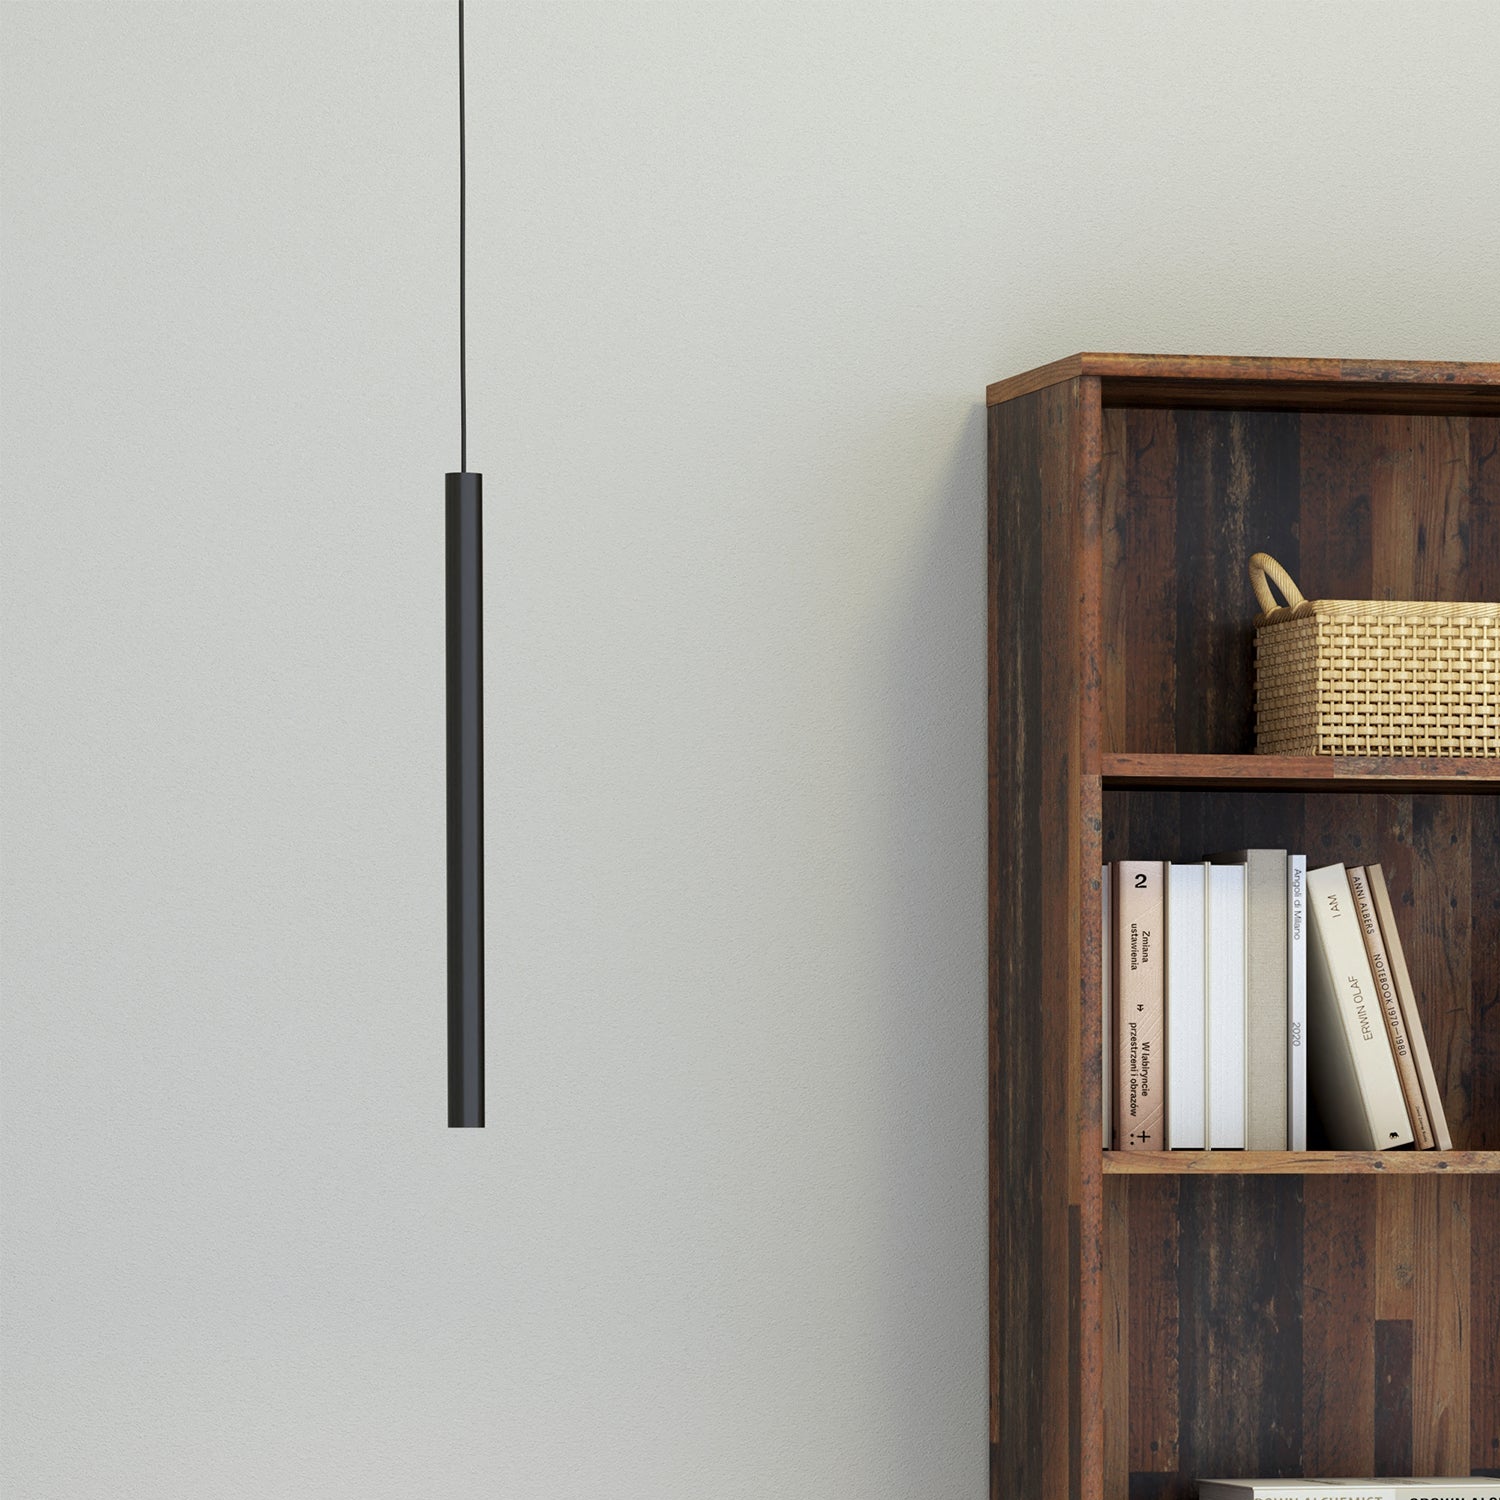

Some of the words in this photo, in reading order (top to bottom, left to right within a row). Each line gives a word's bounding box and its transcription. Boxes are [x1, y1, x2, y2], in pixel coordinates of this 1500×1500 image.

[1134, 873, 1148, 889] 2
[1293, 868, 1302, 897] Angoli
[1293, 899, 1302, 909] di
[1327, 894, 1341, 912] AM
[1352, 876, 1366, 901] ANNI
[1360, 902, 1375, 935] ALBERS
[1293, 910, 1302, 941] Milano
[1130, 923, 1139, 971] ustawienia
[1142, 930, 1151, 963] Zmiana
[1347, 975, 1364, 1004] OLAF
[1373, 953, 1394, 1006] NOTEBOOK
[1292, 1021, 1301, 1047] 2020
[1356, 1005, 1374, 1041] ERWIN
[1128, 1022, 1139, 1072] przestrzeni
[1142, 1041, 1151, 1051] W
[1139, 1053, 1151, 1097] labiryncie
[1130, 1078, 1139, 1117] obrazów
